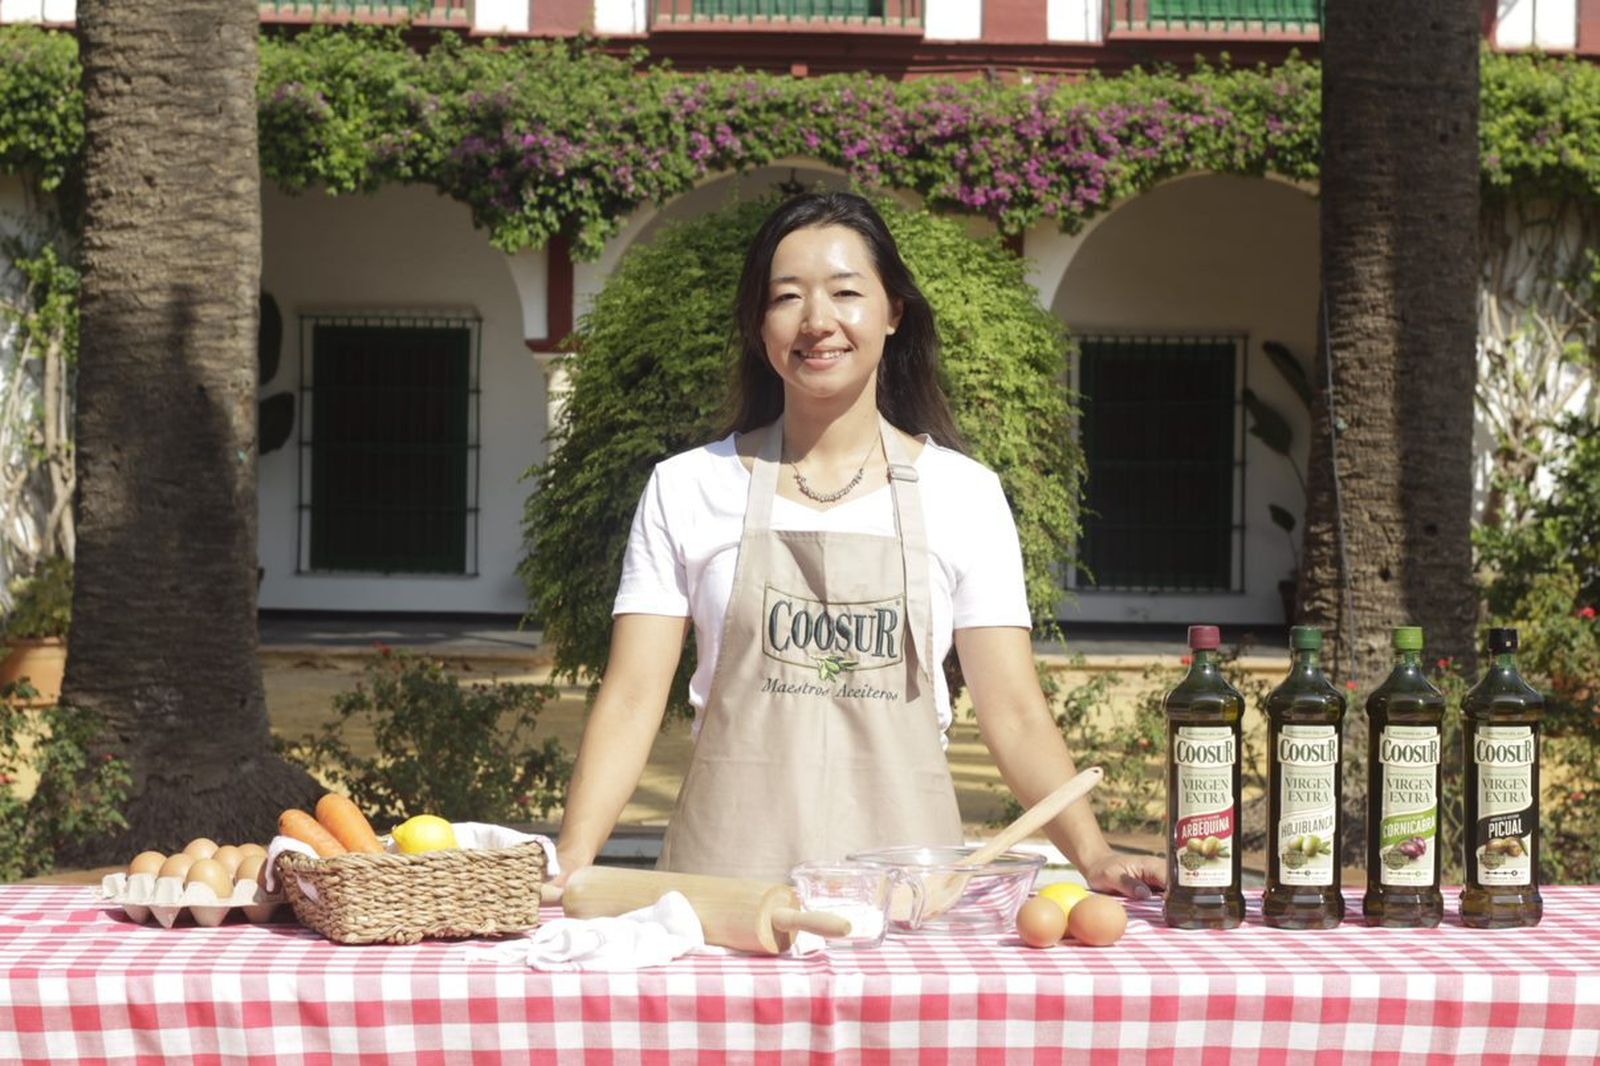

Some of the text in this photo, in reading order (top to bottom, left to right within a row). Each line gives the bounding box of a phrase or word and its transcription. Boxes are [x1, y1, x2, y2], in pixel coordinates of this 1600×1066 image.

[762, 677, 898, 700] Maestros Aceiteros
[1181, 778, 1229, 791] VIRGEN
[1284, 777, 1332, 789] VIRGEN
[1386, 778, 1432, 790] VIRGEN
[1482, 778, 1528, 790] VIRGEN
[1185, 791, 1227, 804] EXTRA
[1287, 790, 1329, 802] EXTRA
[1389, 791, 1430, 803] EXTRA
[1485, 791, 1527, 803] EXTRA
[1488, 818, 1524, 839] PICUAL
